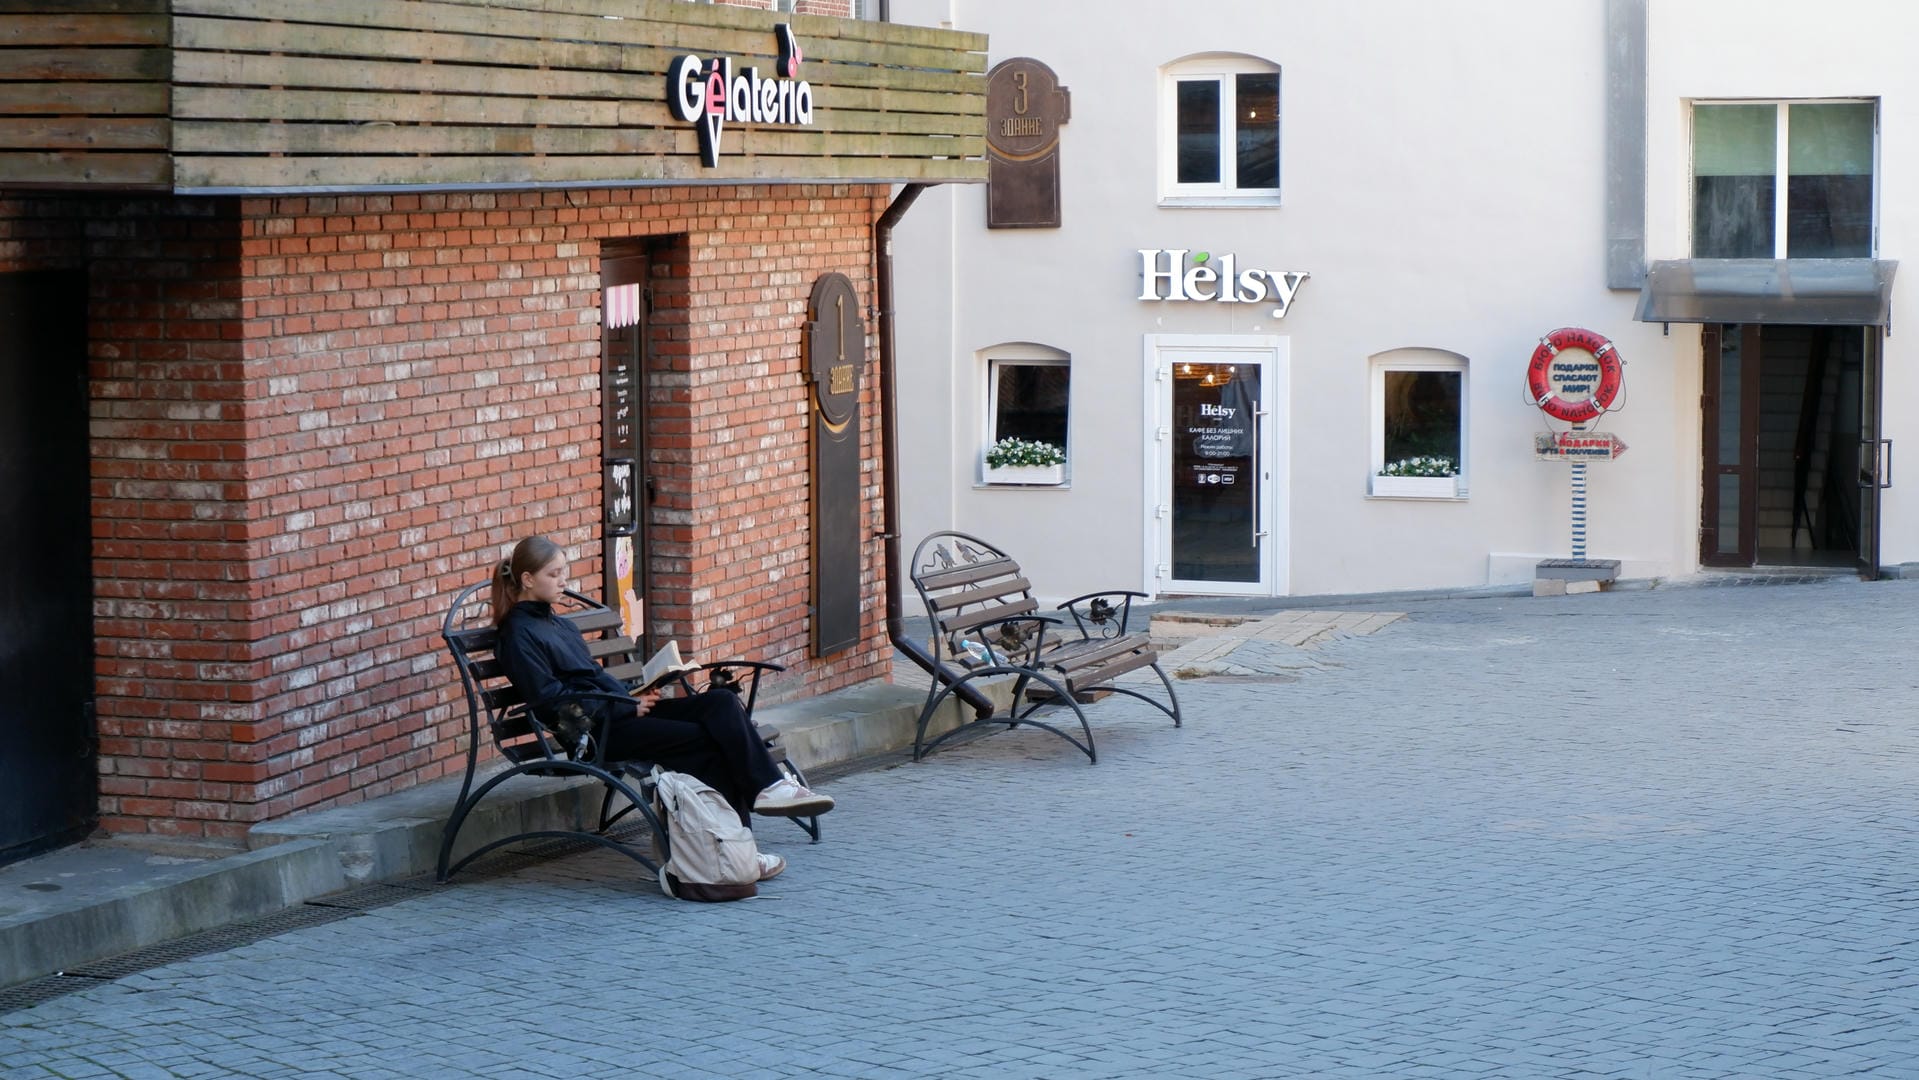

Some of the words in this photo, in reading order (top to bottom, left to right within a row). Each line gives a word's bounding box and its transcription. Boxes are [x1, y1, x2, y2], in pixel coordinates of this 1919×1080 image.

[1013, 72, 1028, 115] 3
[1000, 118, 1042, 136] ЗДАНИЕ
[836, 294, 845, 360] 1
[1553, 363, 1598, 372] ПОДАРКИ
[1553, 374, 1598, 382] СПАСАЮТ
[1562, 384, 1590, 393] МИР!
[1559, 439, 1610, 448] ПОДАРКИ
